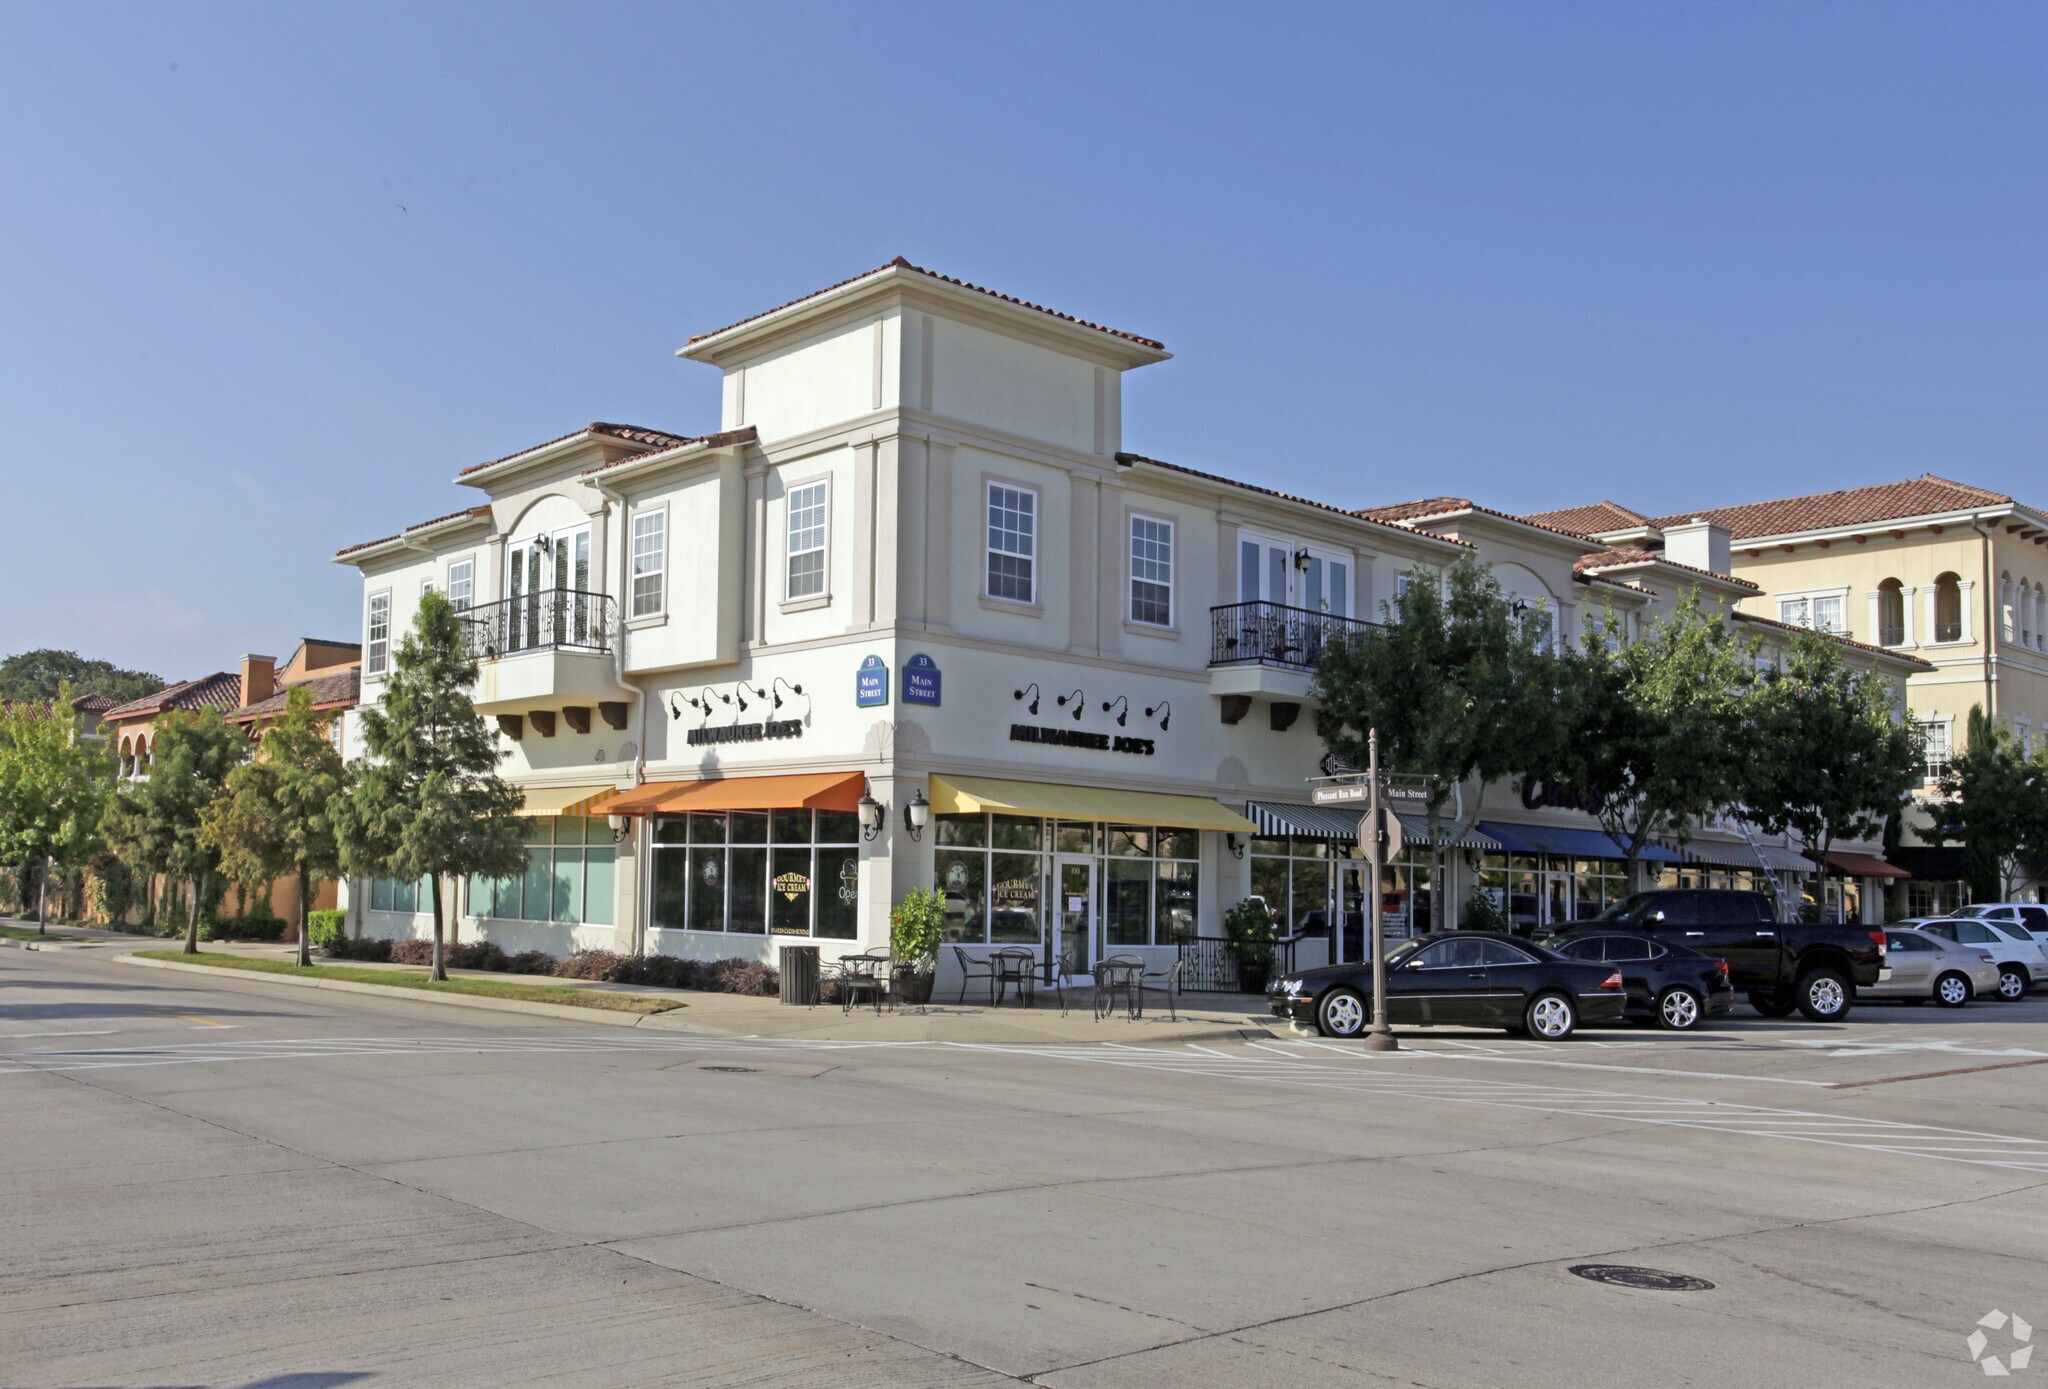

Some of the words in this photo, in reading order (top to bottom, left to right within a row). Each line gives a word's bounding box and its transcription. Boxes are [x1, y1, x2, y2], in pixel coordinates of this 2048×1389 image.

[868, 658, 875, 667] 33
[919, 657, 928, 666] 33
[687, 723, 763, 745] MILWAUKEE
[1009, 724, 1110, 750] MILWAUKEE
[1317, 791, 1338, 801] Pleasant
[1388, 788, 1405, 798] Main
[1407, 788, 1428, 799] Street
[776, 872, 807, 883] GOURMET
[777, 883, 786, 892] ICE
[787, 883, 807, 892] CREAM
[996, 879, 1034, 890] GOURMET
[839, 886, 858, 900] Ope
[997, 890, 1008, 899] ICE
[1010, 890, 1035, 899] CREAM
